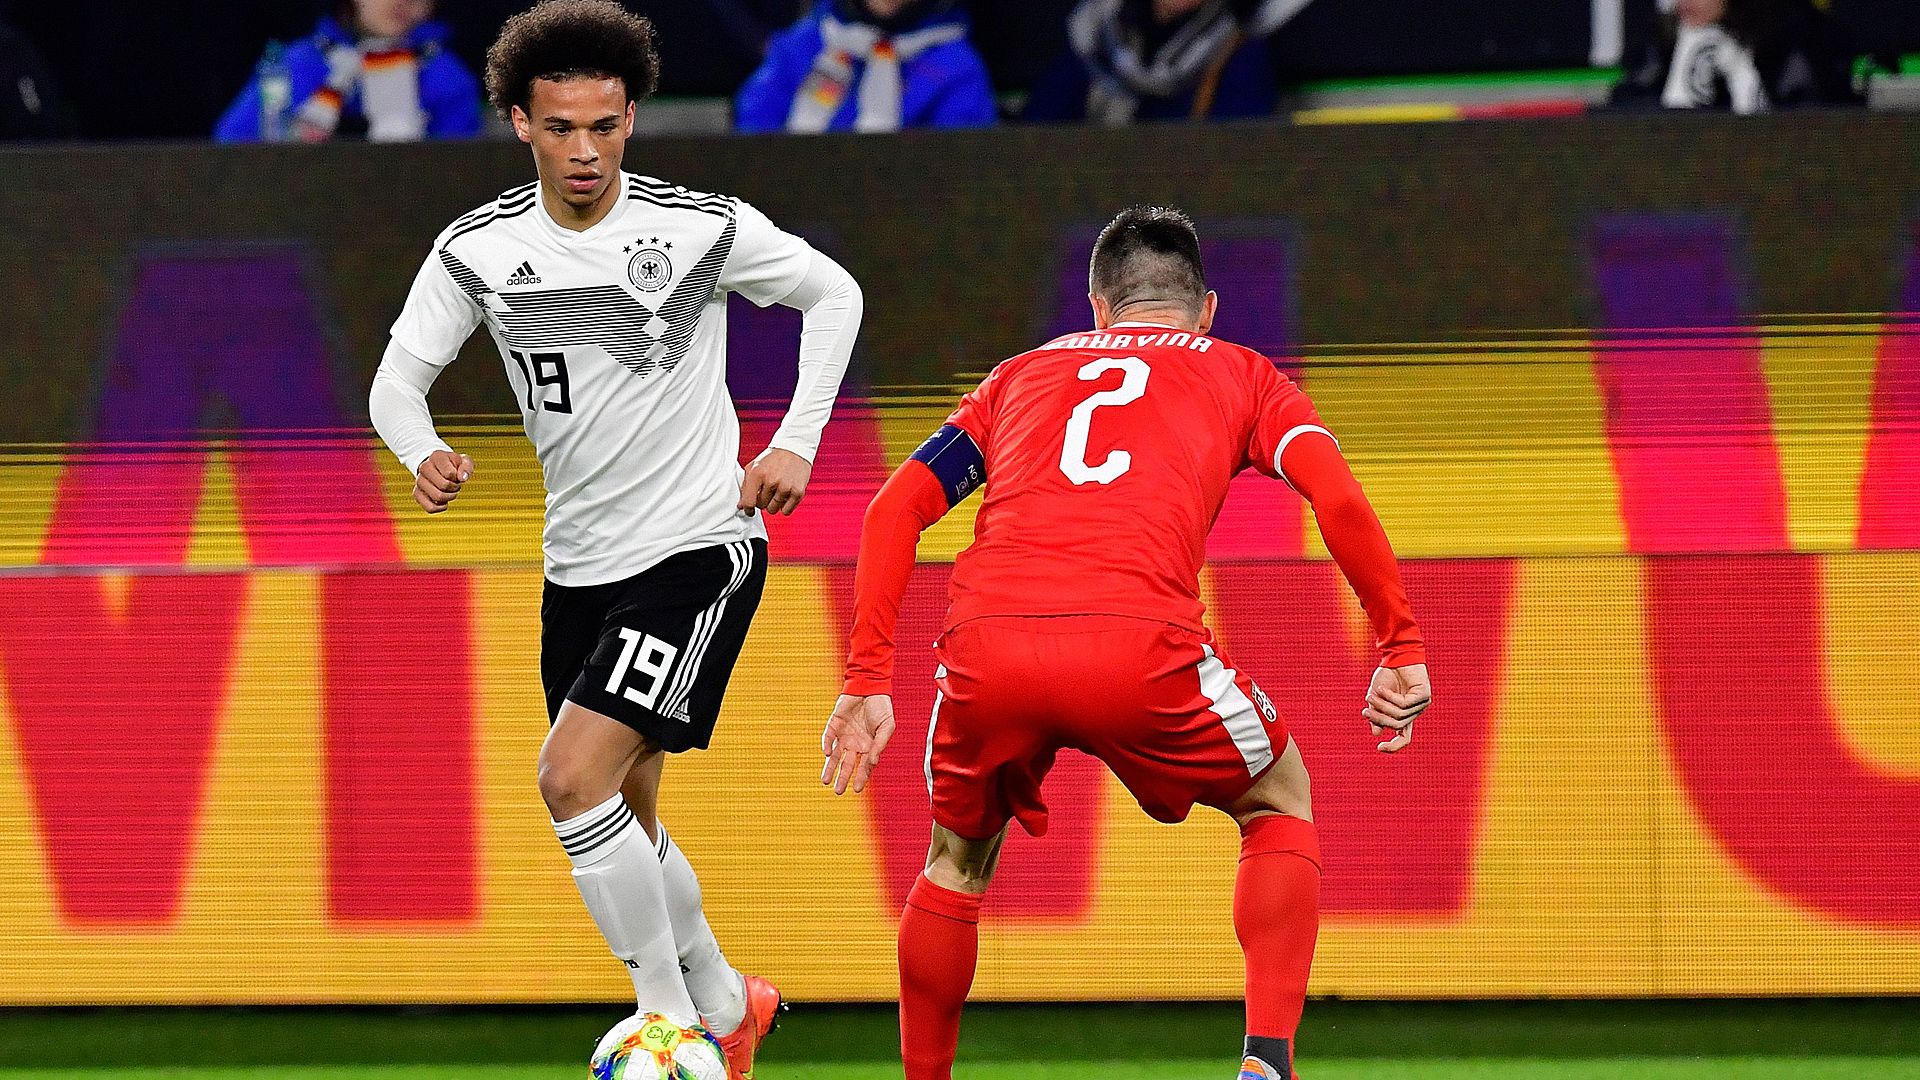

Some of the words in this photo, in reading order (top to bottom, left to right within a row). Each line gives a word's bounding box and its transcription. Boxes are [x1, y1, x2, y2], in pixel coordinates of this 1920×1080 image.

[506, 276, 542, 286] adidas
[509, 349, 573, 415] 19
[1059, 355, 1152, 487] 2
[604, 626, 679, 711] 19
